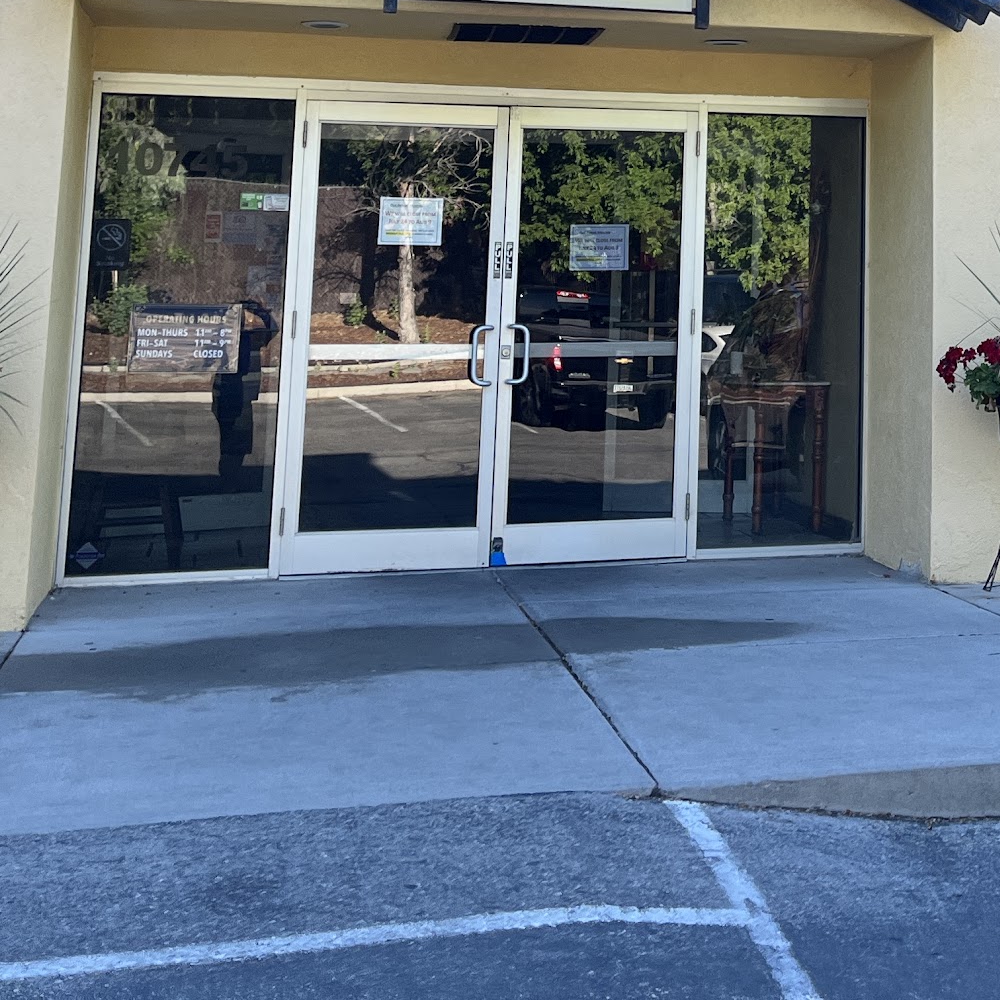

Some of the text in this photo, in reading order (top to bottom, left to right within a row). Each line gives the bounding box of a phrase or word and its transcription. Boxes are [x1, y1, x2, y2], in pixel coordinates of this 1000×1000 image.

[107, 138, 248, 179] 10745
[505, 244, 513, 271] PULL
[145, 315, 227, 325] OPERATING HOURS
[137, 328, 188, 337] MON-THURS
[136, 339, 168, 347] FRI-SAT
[135, 350, 224, 358] SUNDAYS CLOSED
